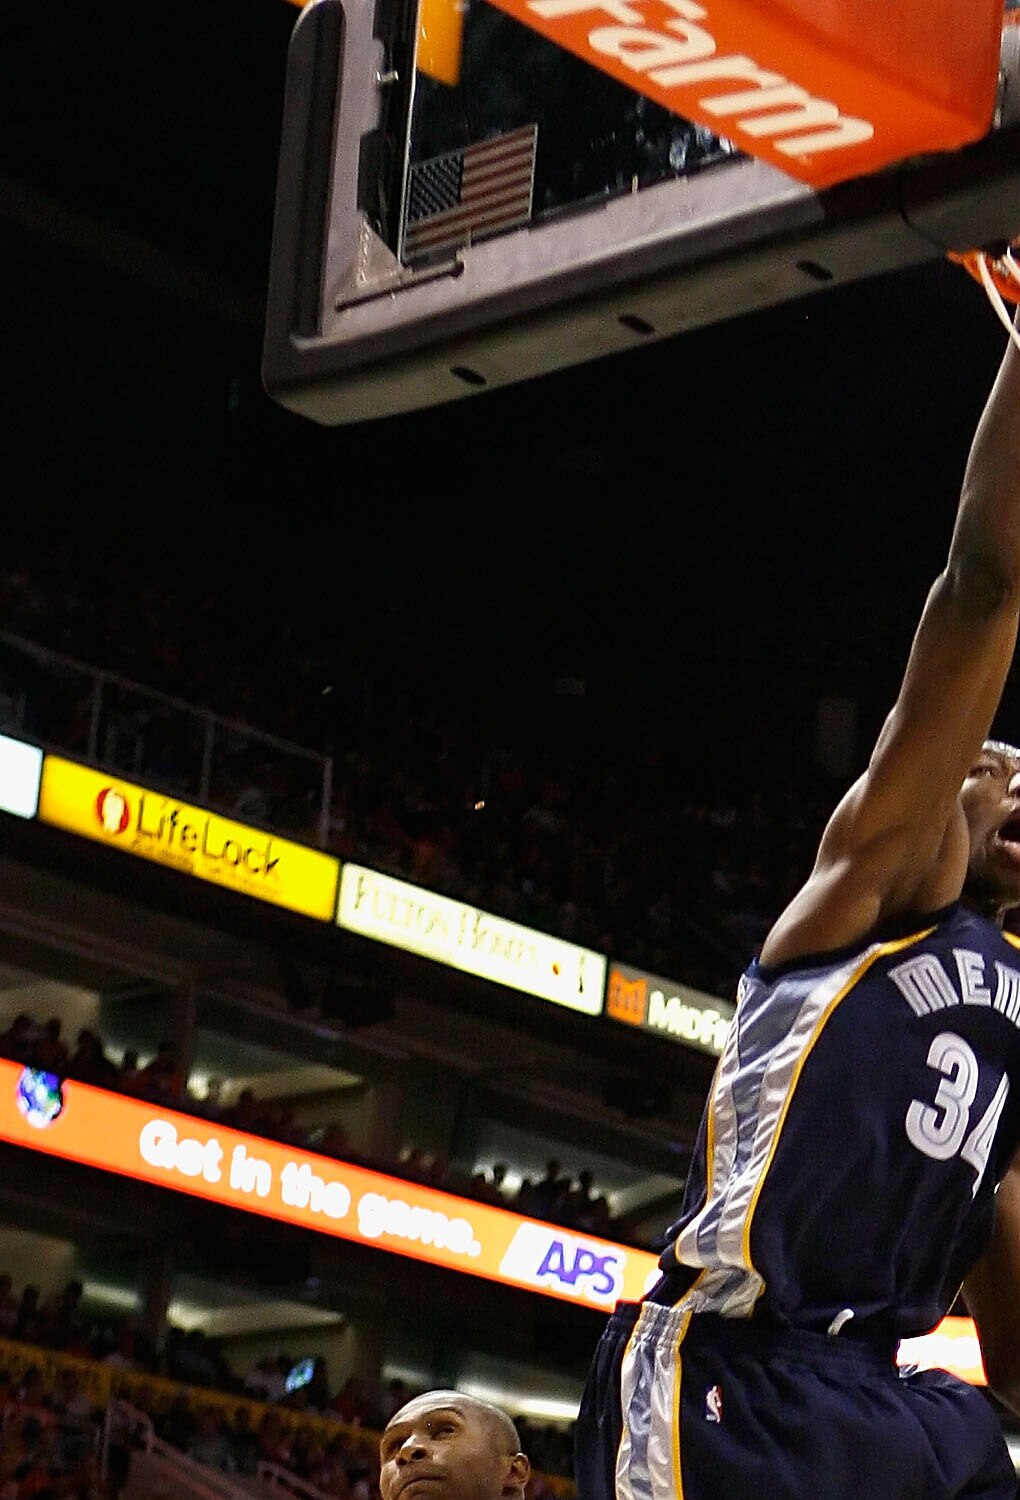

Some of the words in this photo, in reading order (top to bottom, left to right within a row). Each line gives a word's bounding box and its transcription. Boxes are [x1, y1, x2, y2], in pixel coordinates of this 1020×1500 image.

[527, 0, 874, 157] Farm
[136, 790, 281, 873] LifeLock
[905, 1031, 1011, 1200] 34
[139, 1119, 223, 1183] Get
[230, 1144, 272, 1196] in
[280, 1163, 352, 1219] the
[357, 1193, 482, 1258] game.
[536, 1240, 621, 1295] APS
